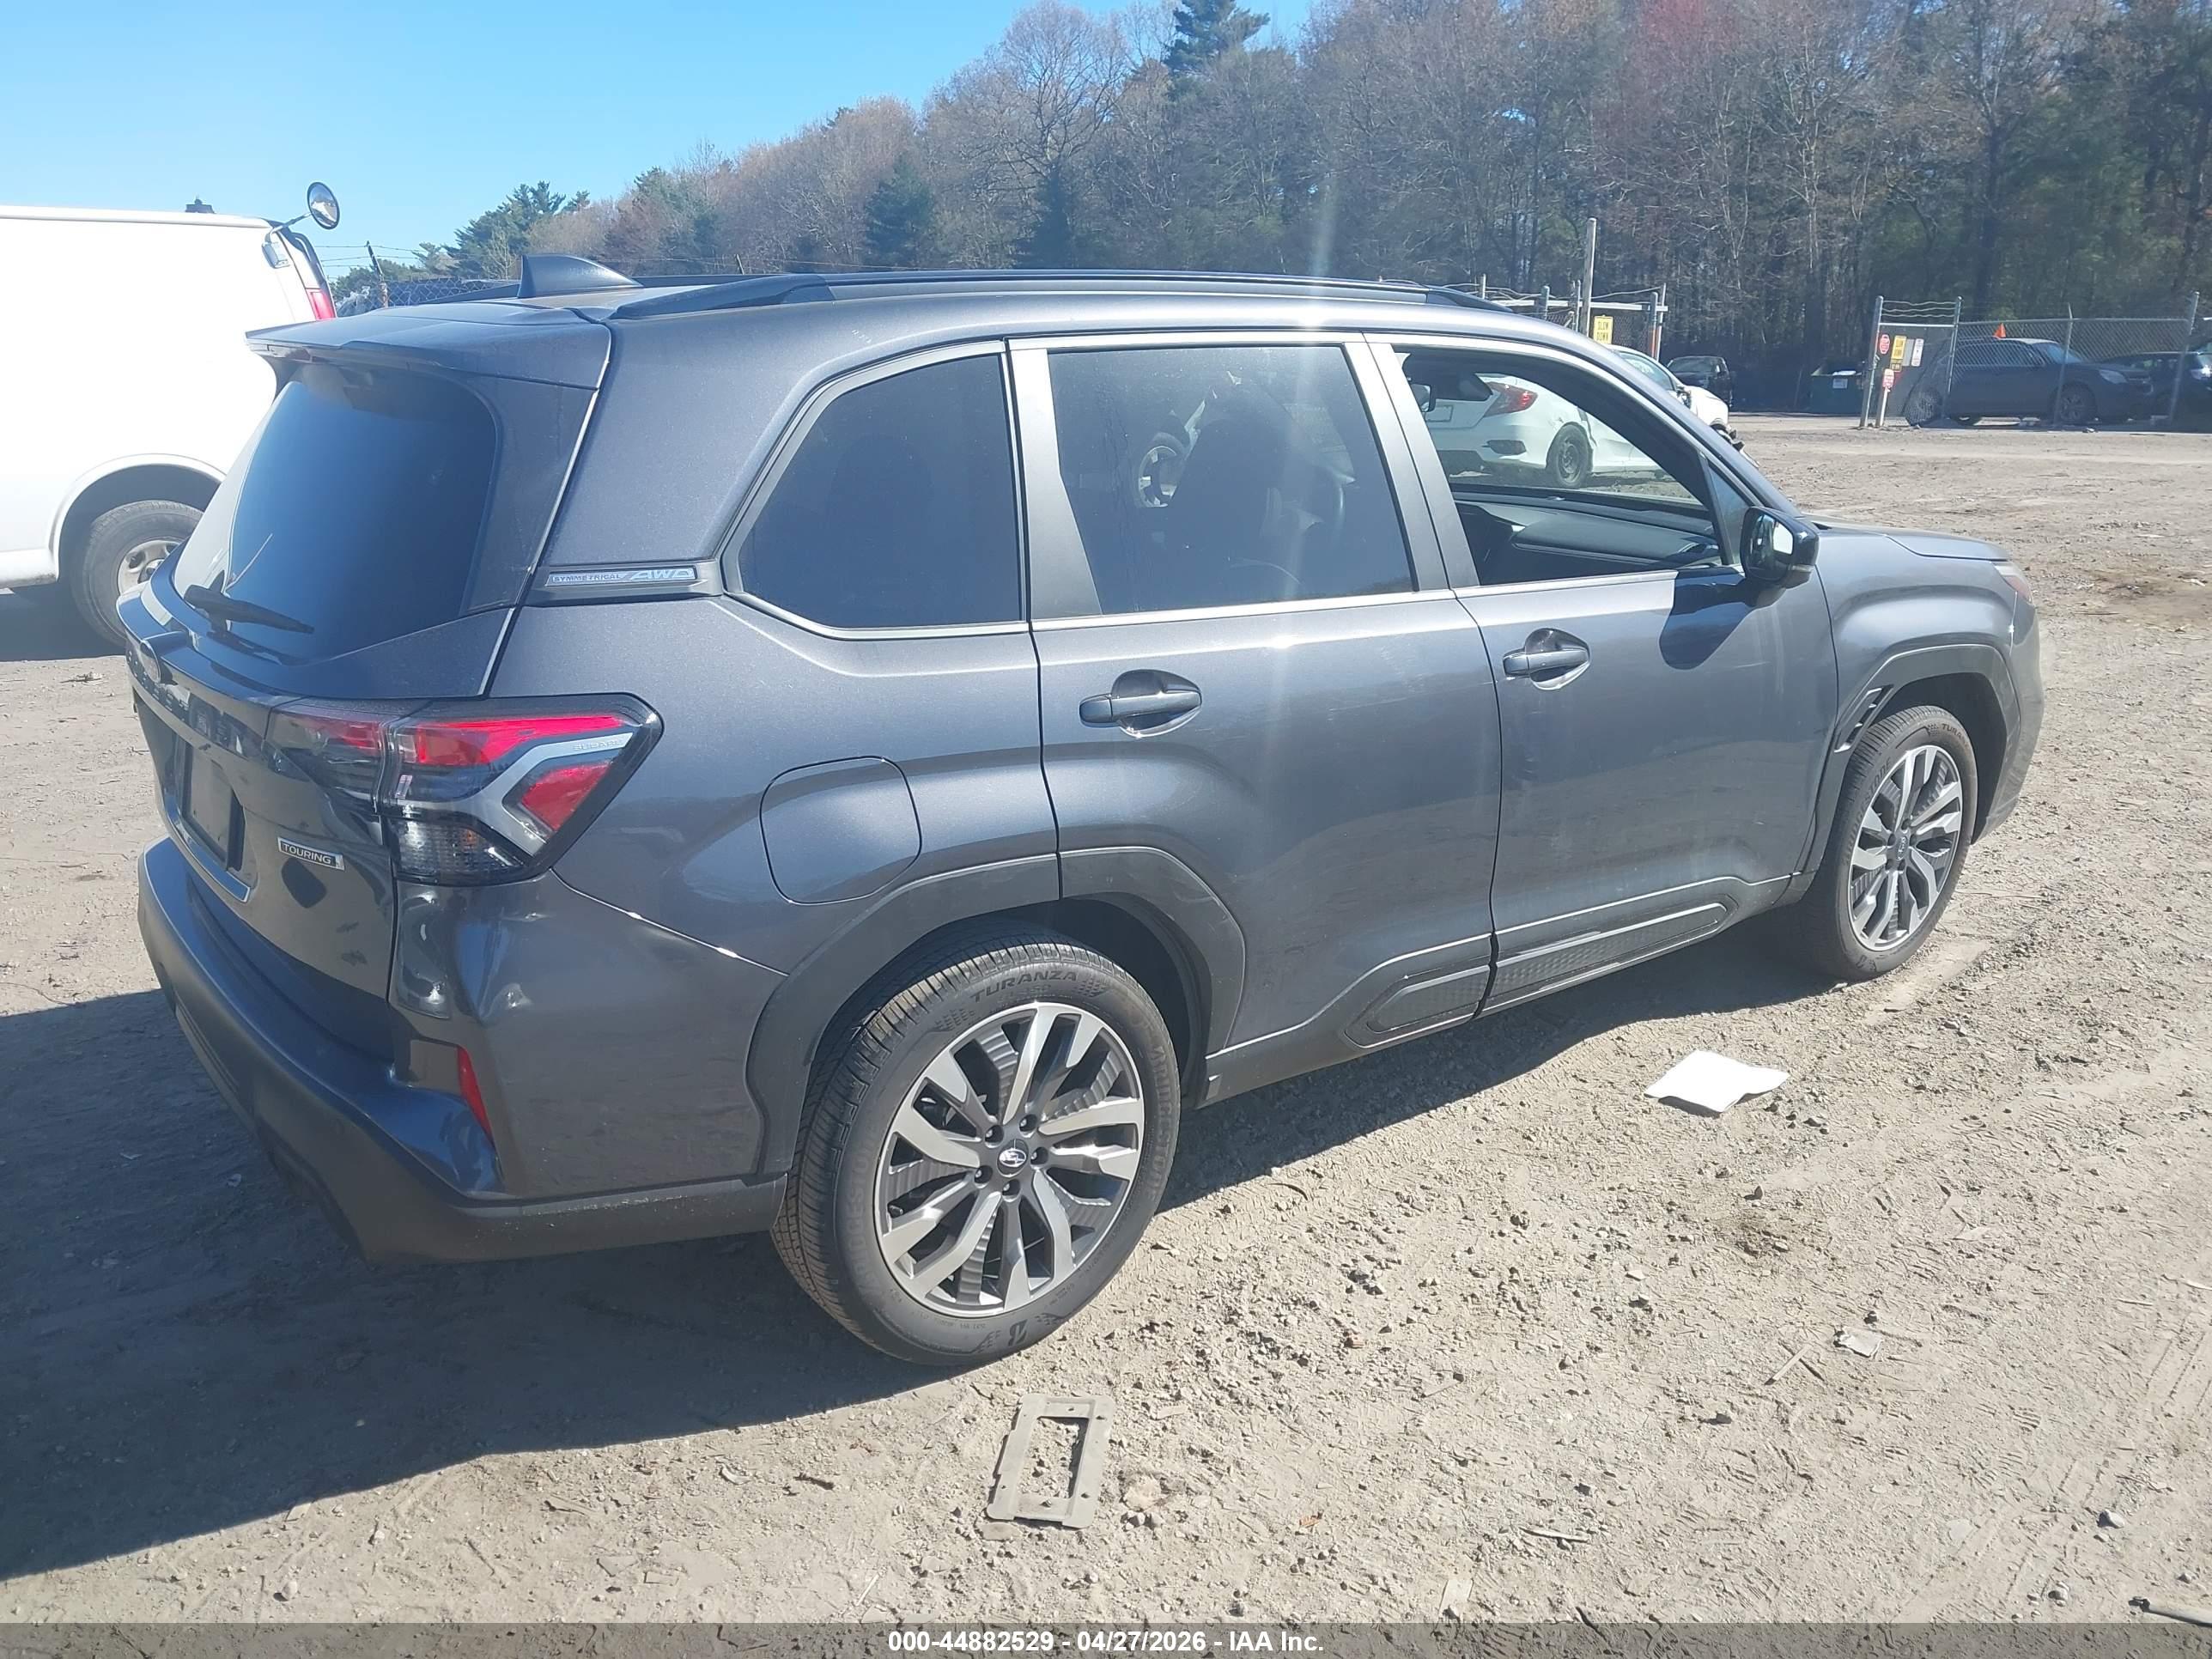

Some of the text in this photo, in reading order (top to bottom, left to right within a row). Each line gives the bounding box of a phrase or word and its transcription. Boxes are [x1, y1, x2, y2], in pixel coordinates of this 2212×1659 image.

[552, 568, 695, 583] SYMMETRICAL AWD
[283, 843, 332, 865] TOURING
[969, 970, 1079, 1003] TURANZA
